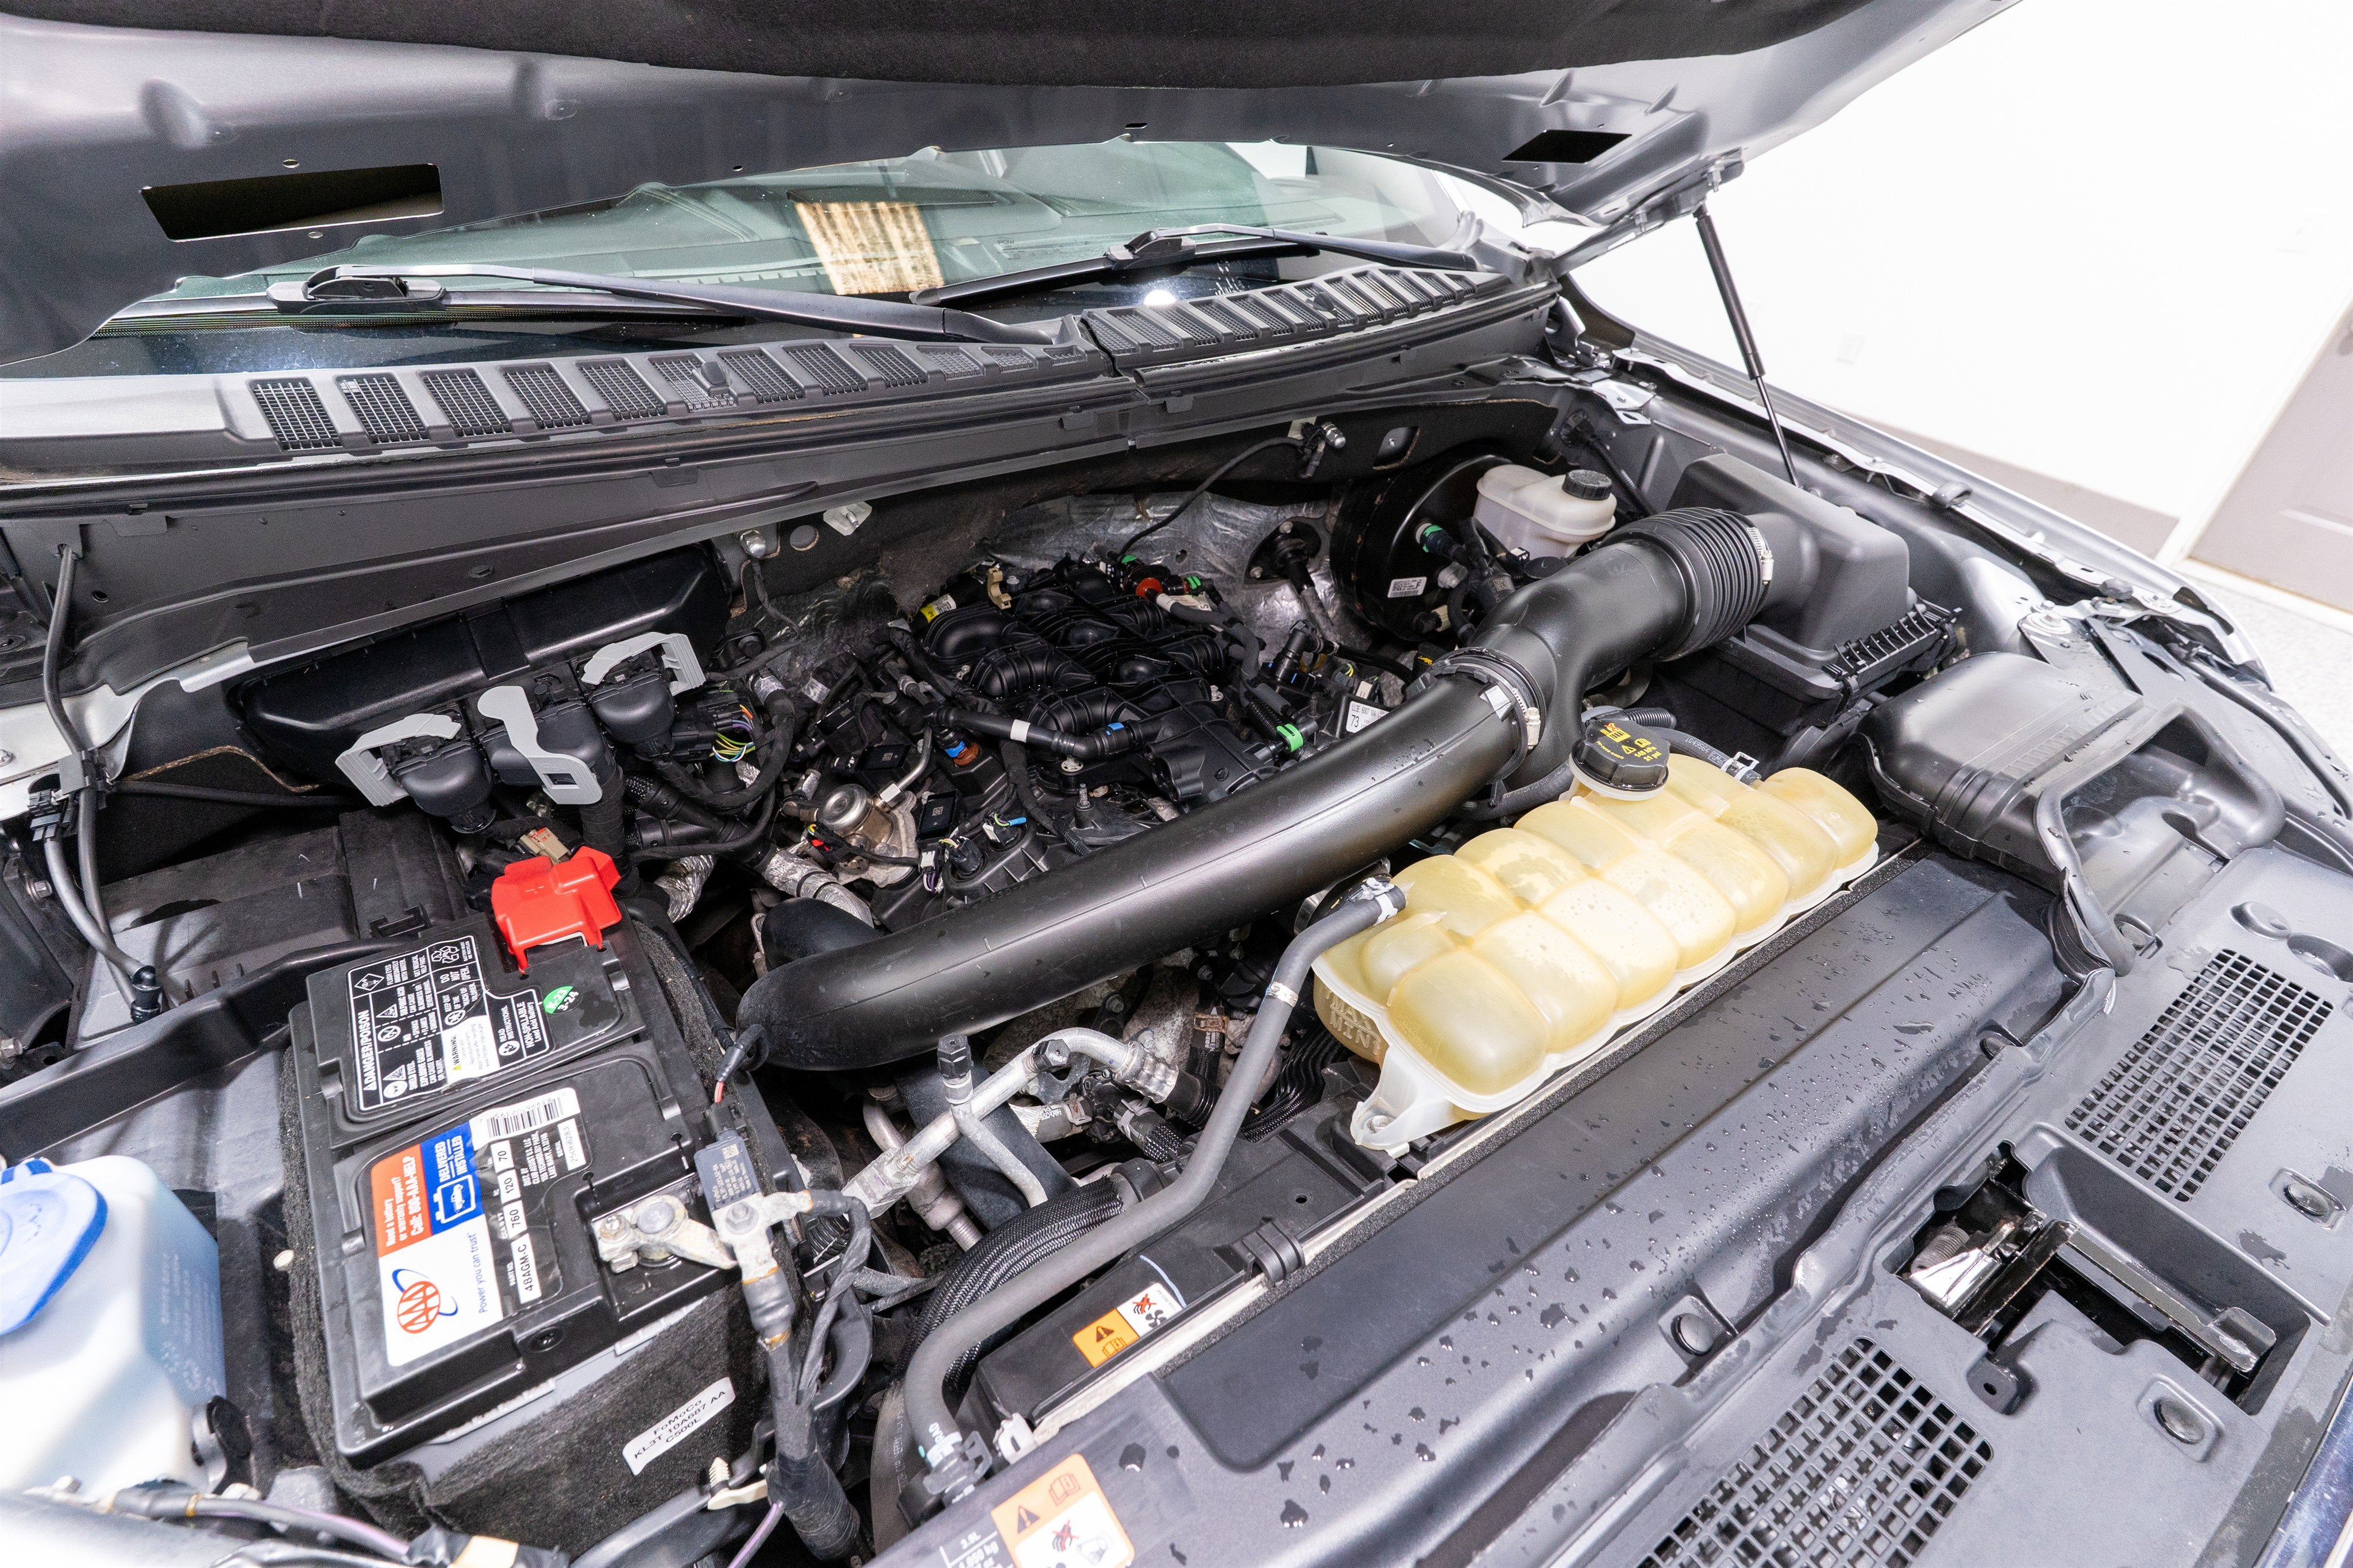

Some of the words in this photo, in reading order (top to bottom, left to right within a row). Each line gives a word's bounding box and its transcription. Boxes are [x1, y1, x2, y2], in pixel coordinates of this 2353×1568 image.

[1351, 715, 1359, 727] 73
[1685, 736, 1710, 753] 1049564
[1710, 752, 1726, 766] FoMoC
[440, 974, 450, 983] DO
[450, 971, 460, 981] NOT
[460, 965, 470, 980] OPEN.
[397, 986, 405, 997] ACID
[416, 990, 425, 1010] BLINDNESS
[426, 994, 434, 1007] SEVERE
[557, 991, 579, 1011] 3-24
[398, 997, 408, 1016] SULFURIC
[527, 1002, 535, 1019] Battery
[411, 1019, 420, 1036] SPARKS
[420, 1017, 429, 1033] FLAMES
[428, 1011, 437, 1030] SMOKING
[502, 1006, 514, 1040] INSTRUCTIONS.
[517, 1002, 534, 1048] NON-SPILLABLE
[530, 1018, 538, 1030] Acid
[1330, 1010, 1371, 1048] MIN
[403, 1033, 411, 1042] NO
[498, 1029, 507, 1042] READ
[533, 1029, 541, 1042] Lead
[358, 1011, 376, 1084] DANGER/POISON
[416, 1048, 426, 1063] GASES
[424, 1040, 434, 1062] BLINDNESS
[451, 1037, 460, 1065] WARNING:
[407, 1060, 416, 1075] EYES.
[418, 1062, 429, 1087] EXPLOSIVE
[427, 1061, 435, 1075] CAUSE
[408, 1073, 418, 1090] SHIELD
[429, 1074, 437, 1084] CAN
[523, 1138, 531, 1148] LLC
[435, 1142, 450, 1182] DELIVERED
[452, 1136, 467, 1175] INSTALLED
[497, 1150, 507, 1162] 70
[526, 1155, 537, 1172] ASSIST
[534, 1145, 546, 1173] TECHNOLOGY
[531, 1171, 540, 1184] CLUB
[547, 1165, 557, 1179] LAKE
[391, 1177, 404, 1204] support?
[403, 1157, 421, 1214] 800-AAA-HELP
[504, 1177, 514, 1194] 120
[384, 1198, 394, 1223] battery
[396, 1203, 406, 1233] warranty
[510, 1209, 520, 1228] 760
[410, 1214, 424, 1236] Call:
[385, 1227, 396, 1246] Need
[399, 1233, 407, 1241] or
[468, 1234, 478, 1253] trust
[472, 1254, 481, 1268] can
[518, 1245, 533, 1291] 48AGM-C
[475, 1269, 485, 1285] you
[508, 1270, 516, 1286] PART
[398, 1281, 440, 1334] AAA
[477, 1288, 487, 1314] Power
[634, 1434, 664, 1458] KL3T
[668, 1403, 707, 1433] 10A687
[711, 1391, 726, 1404] AA
[654, 1400, 701, 1435] FoMoCo
[666, 1418, 701, 1443] C500L
